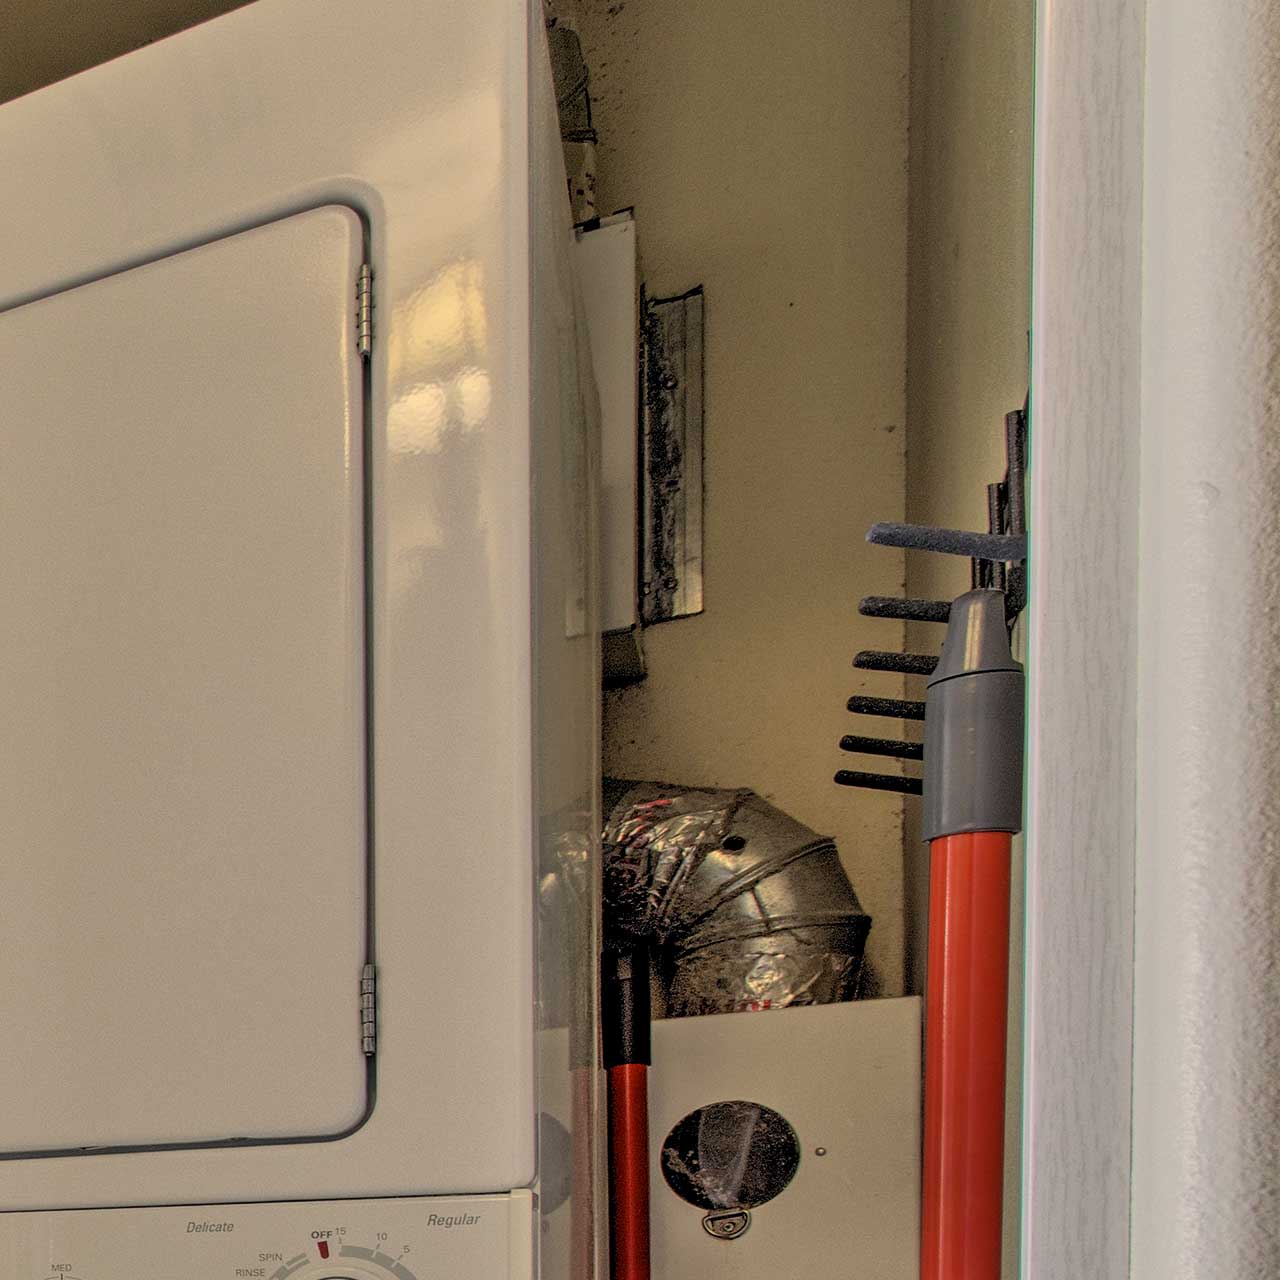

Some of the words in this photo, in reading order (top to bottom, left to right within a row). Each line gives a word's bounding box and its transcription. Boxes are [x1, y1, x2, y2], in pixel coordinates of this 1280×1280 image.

[428, 1212, 480, 1227] Regular
[186, 1221, 234, 1233] Delicate
[311, 1231, 332, 1239] OFF
[335, 1228, 346, 1236] 15
[376, 1233, 387, 1241] 10
[404, 1246, 410, 1254] 5
[259, 1254, 283, 1262] SPIN
[52, 1264, 72, 1272] MED
[235, 1269, 265, 1277] RINSE
